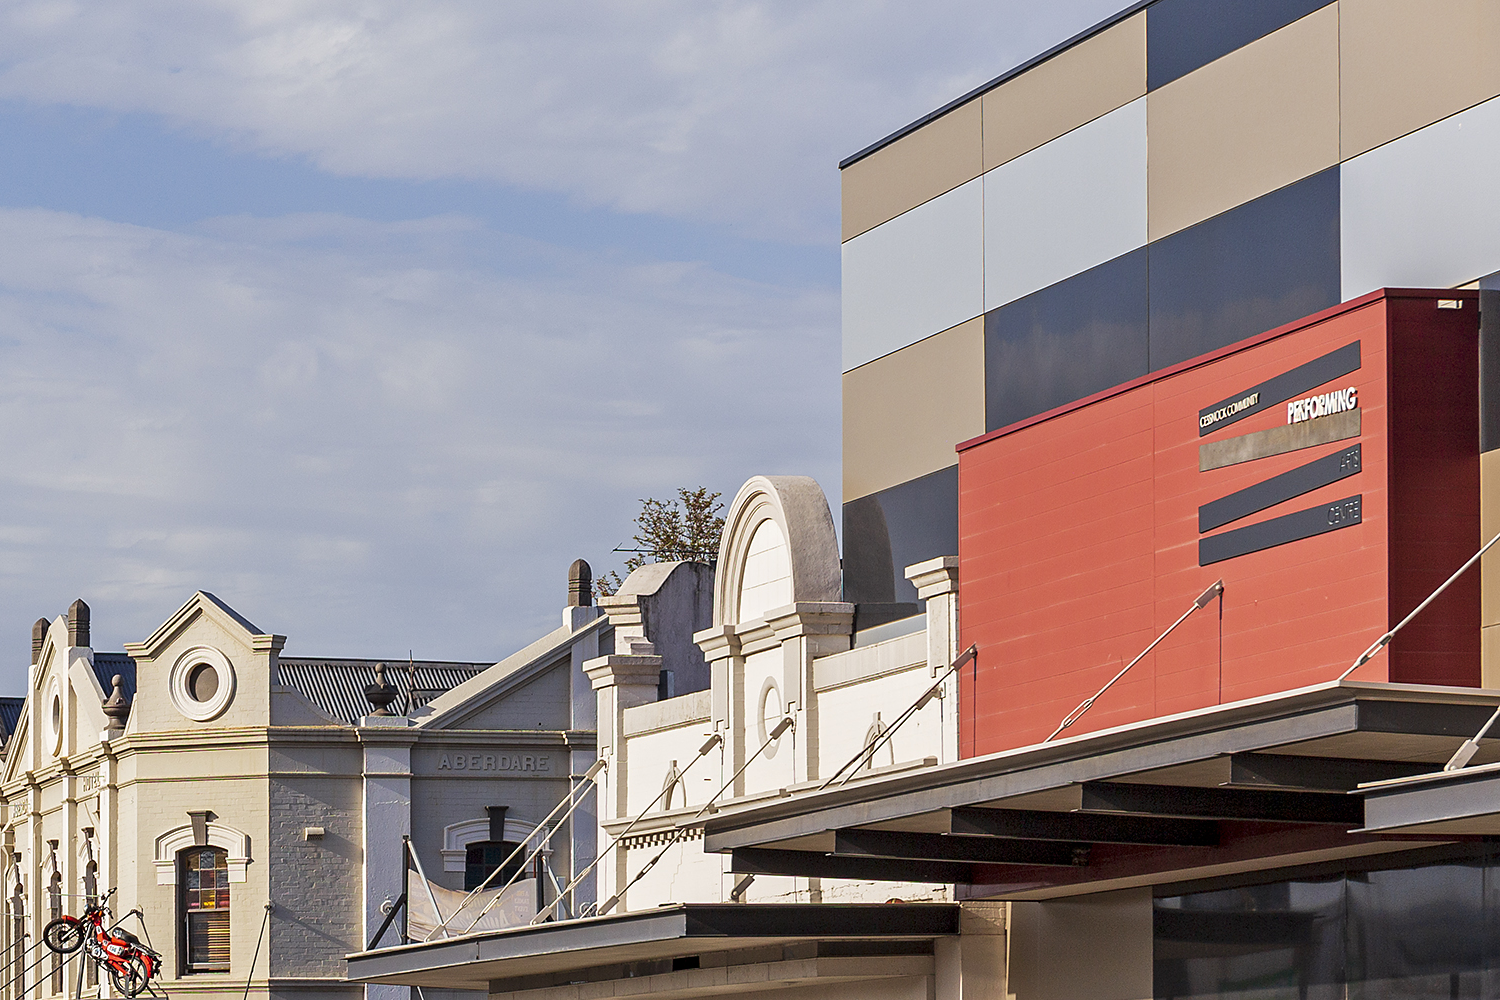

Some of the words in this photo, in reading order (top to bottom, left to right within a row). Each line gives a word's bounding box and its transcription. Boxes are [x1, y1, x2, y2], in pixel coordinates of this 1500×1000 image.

[1200, 406, 1228, 428] CESSNOCK
[1226, 392, 1260, 416] COMMUNITY
[1287, 386, 1358, 425] PERFORMING
[1339, 449, 1359, 473] ARTS
[1327, 500, 1359, 526] CENTRE
[438, 752, 550, 772] ABERDARE
